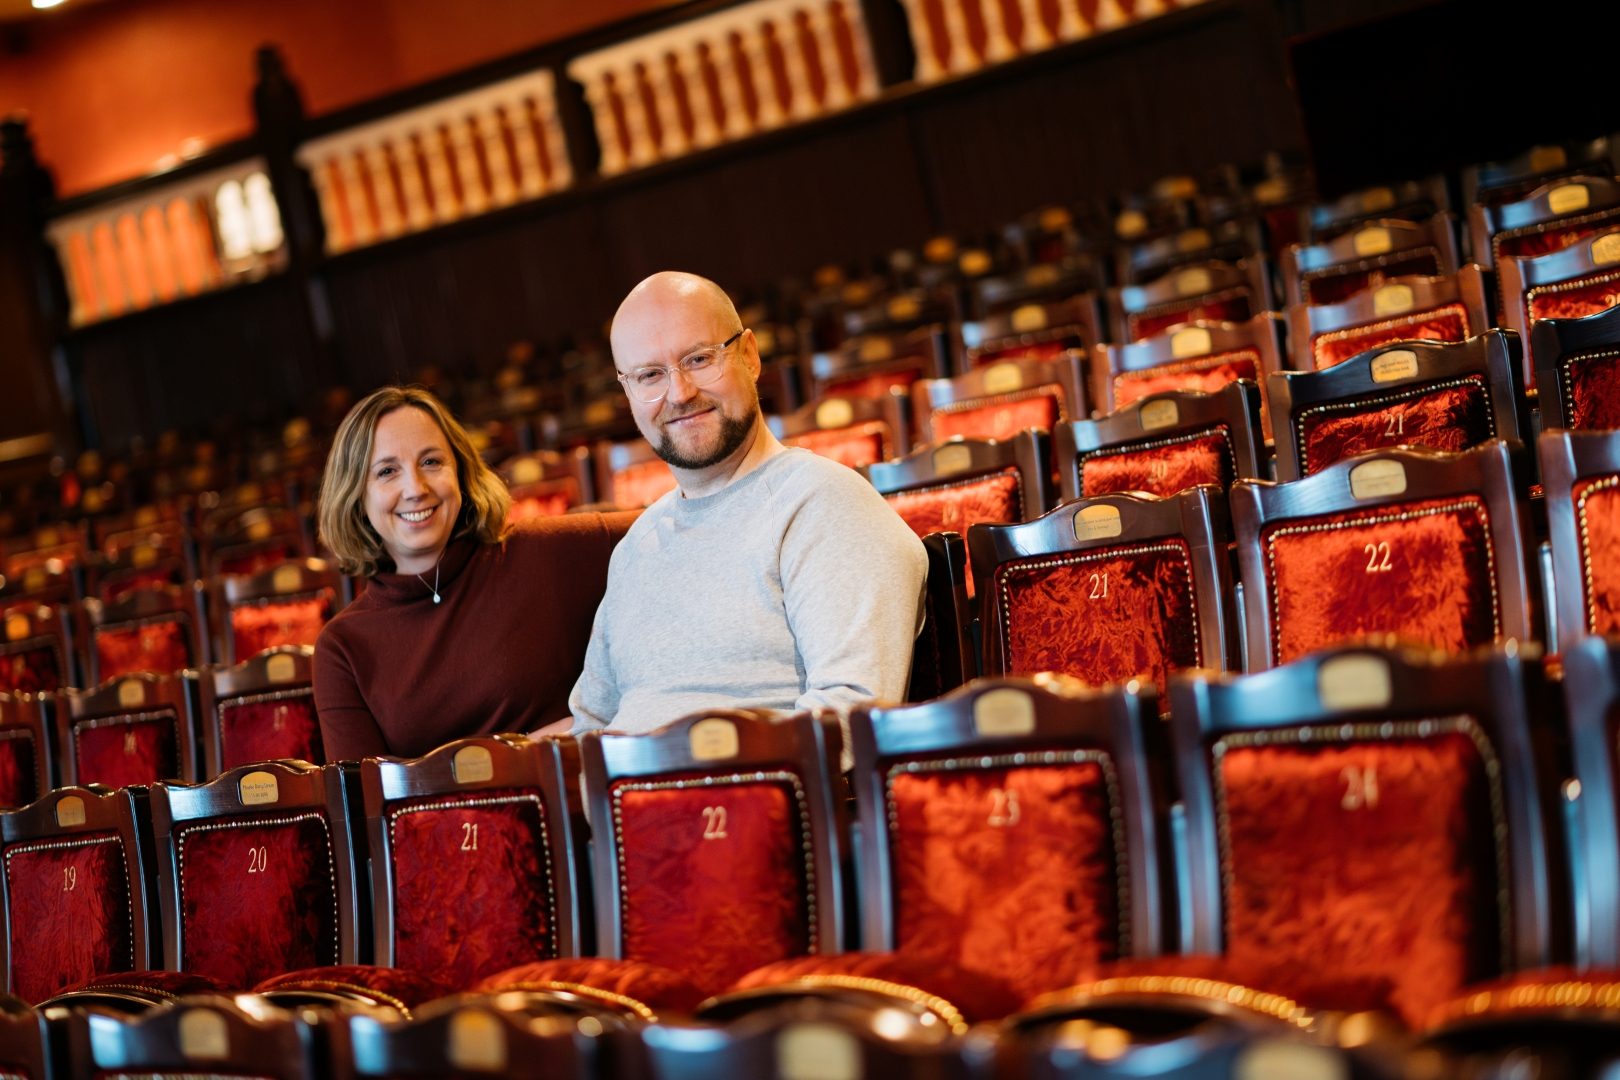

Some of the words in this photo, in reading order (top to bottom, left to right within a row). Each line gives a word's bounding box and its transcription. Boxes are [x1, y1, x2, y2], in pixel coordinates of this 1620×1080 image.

[1384, 412, 1403, 437] 21
[1364, 541, 1392, 573] 22
[1089, 572, 1108, 599] 21
[1340, 764, 1379, 811] 24
[986, 787, 1021, 827] 23
[461, 822, 478, 850] 21
[702, 805, 727, 839] 22
[248, 846, 267, 873] 20
[63, 865, 76, 891] 19
